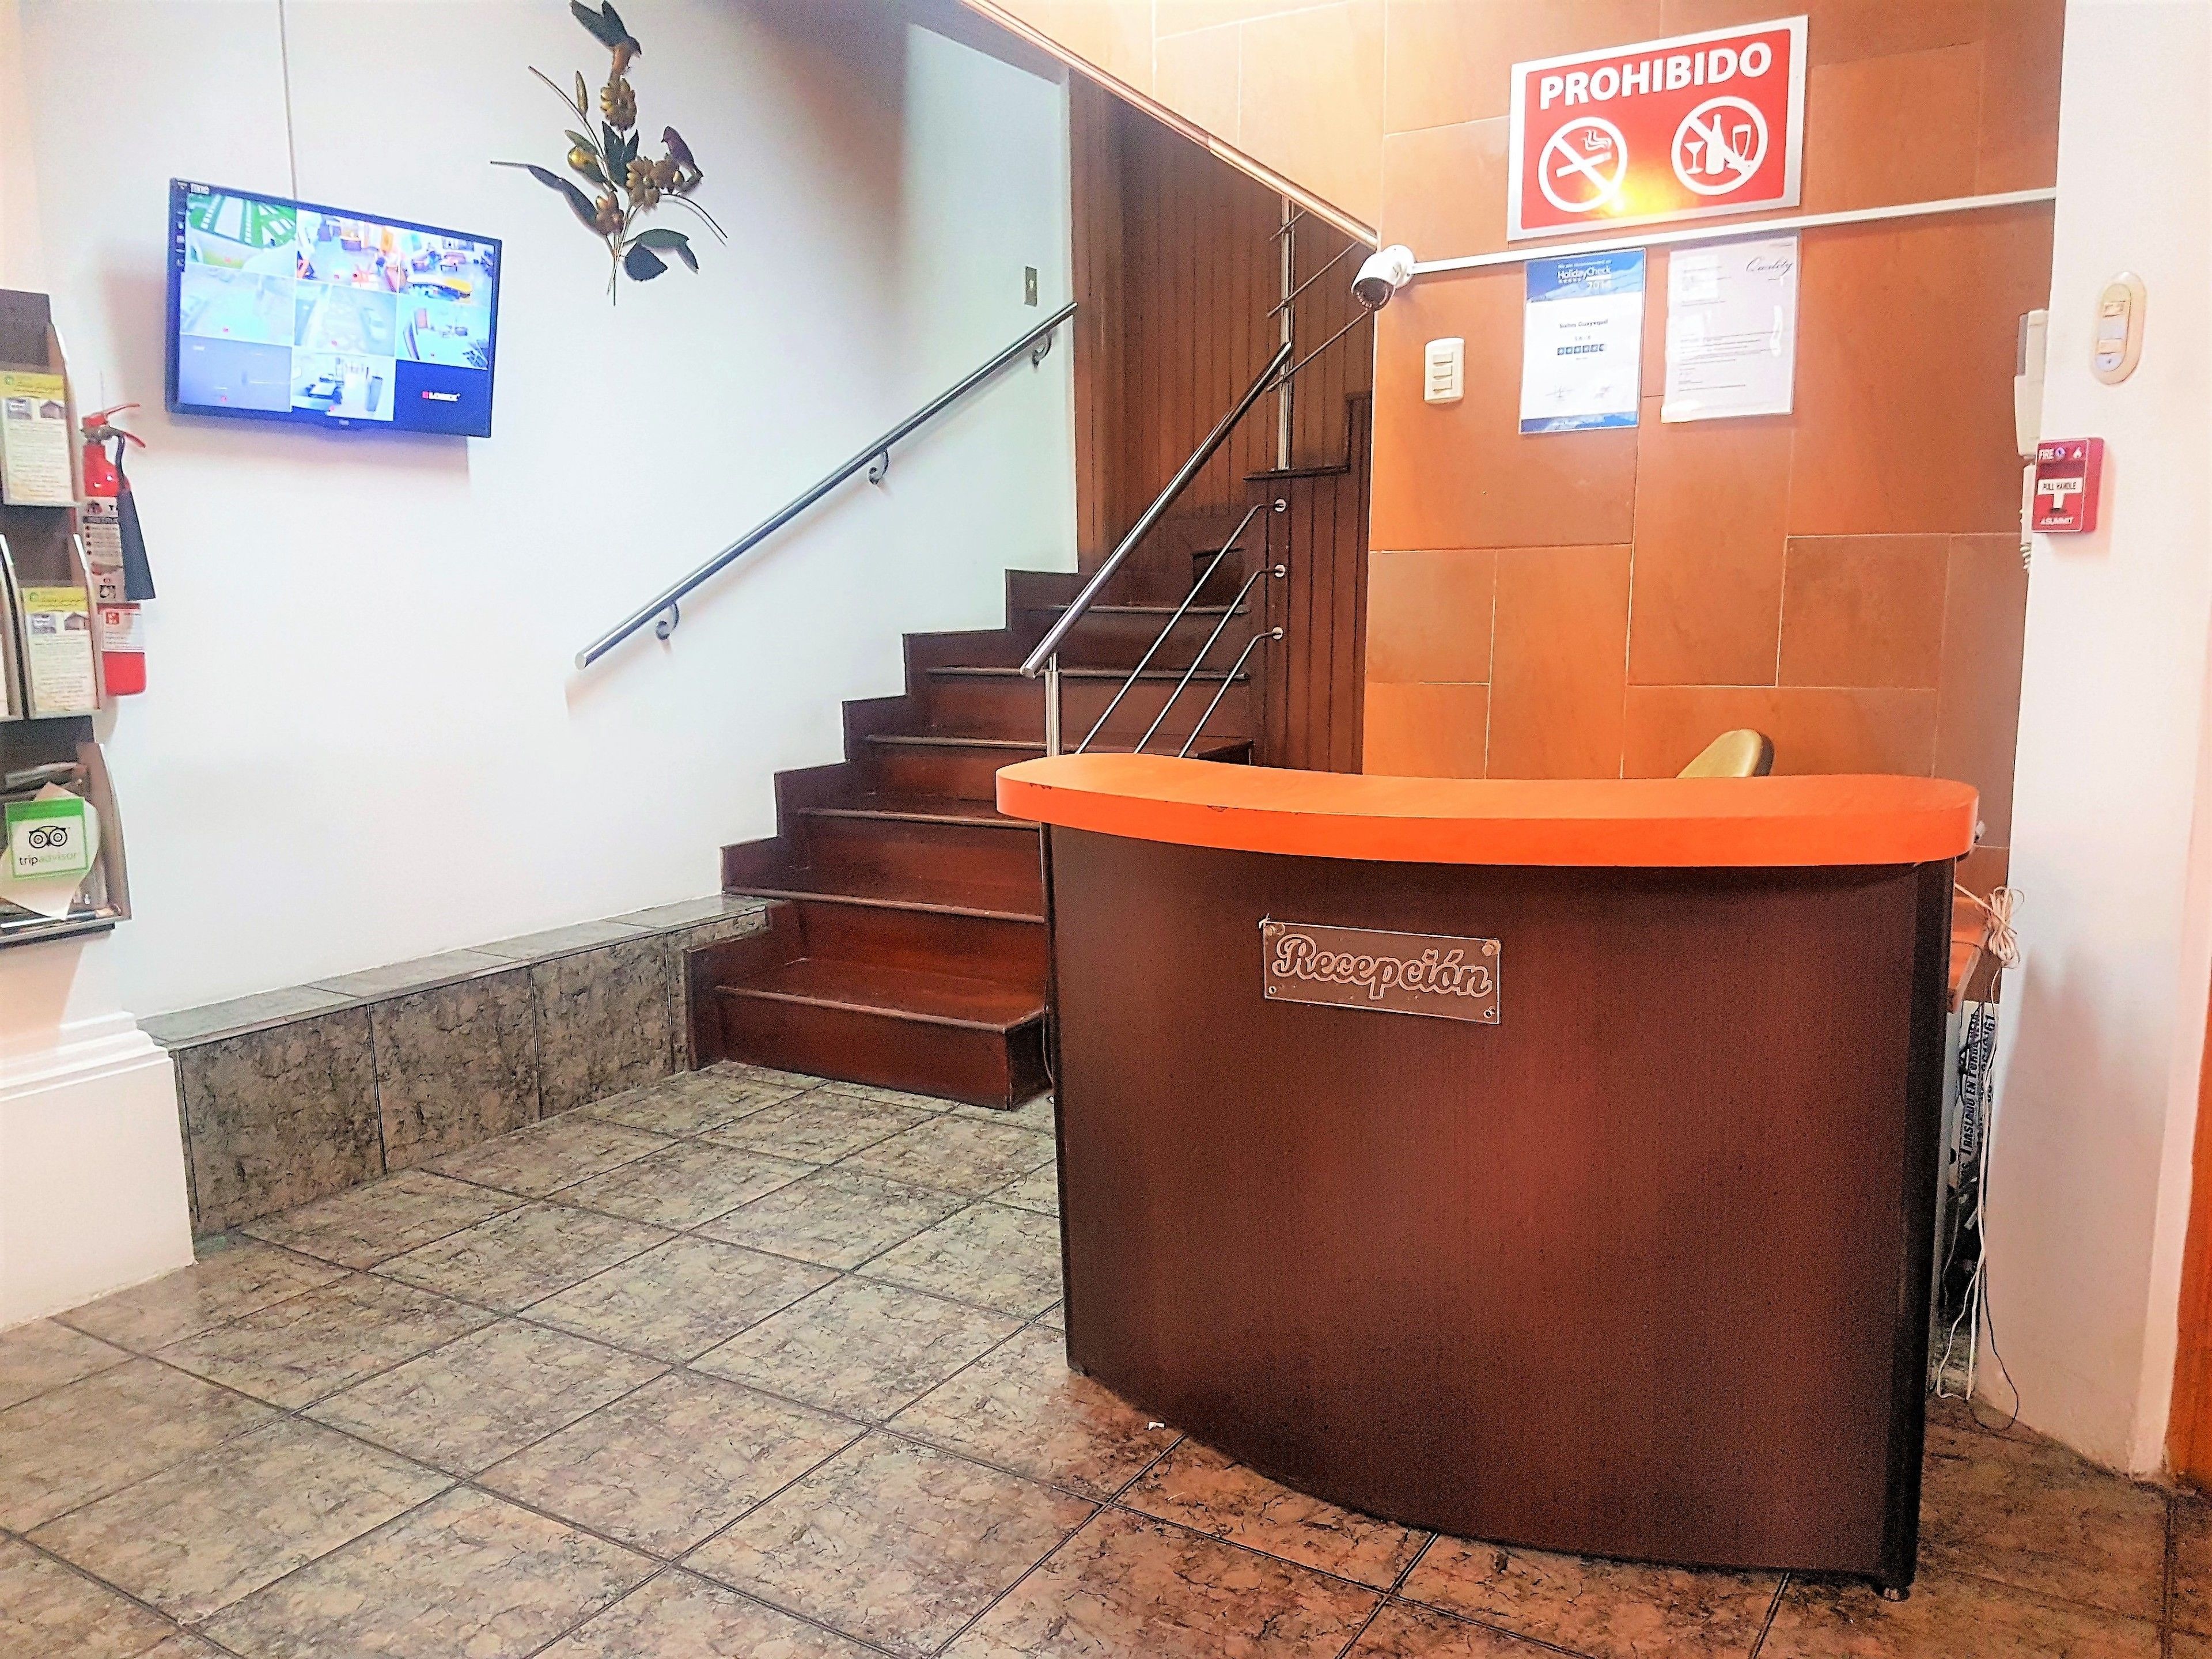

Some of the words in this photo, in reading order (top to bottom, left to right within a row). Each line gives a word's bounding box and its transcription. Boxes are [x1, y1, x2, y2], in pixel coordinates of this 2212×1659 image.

[1539, 41, 1773, 110] PROHIBIDO
[1558, 266, 1611, 279] HolidayCheck
[2039, 448, 2055, 460] FIRE
[2042, 483, 2054, 491] PULL
[2056, 482, 2077, 490] HANDLE
[20, 852, 77, 866] tripadvisor
[1272, 933, 1493, 1000] Recepción
[1965, 1081, 1976, 1096] EN
